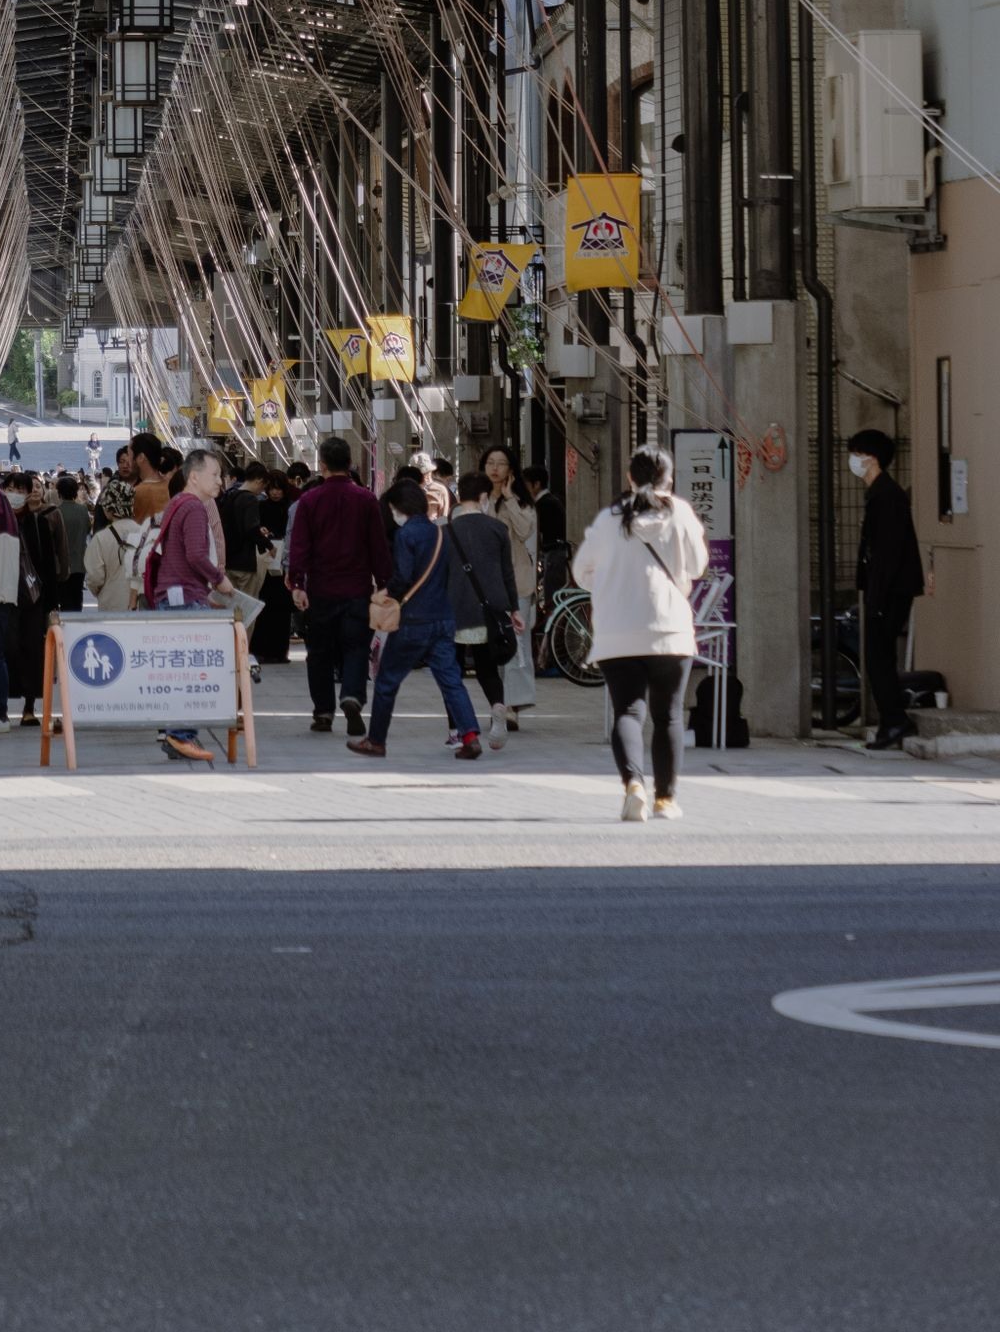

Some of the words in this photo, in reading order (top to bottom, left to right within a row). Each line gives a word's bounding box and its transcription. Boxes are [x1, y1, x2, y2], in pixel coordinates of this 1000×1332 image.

[130, 649, 225, 669] 歩行者道路
